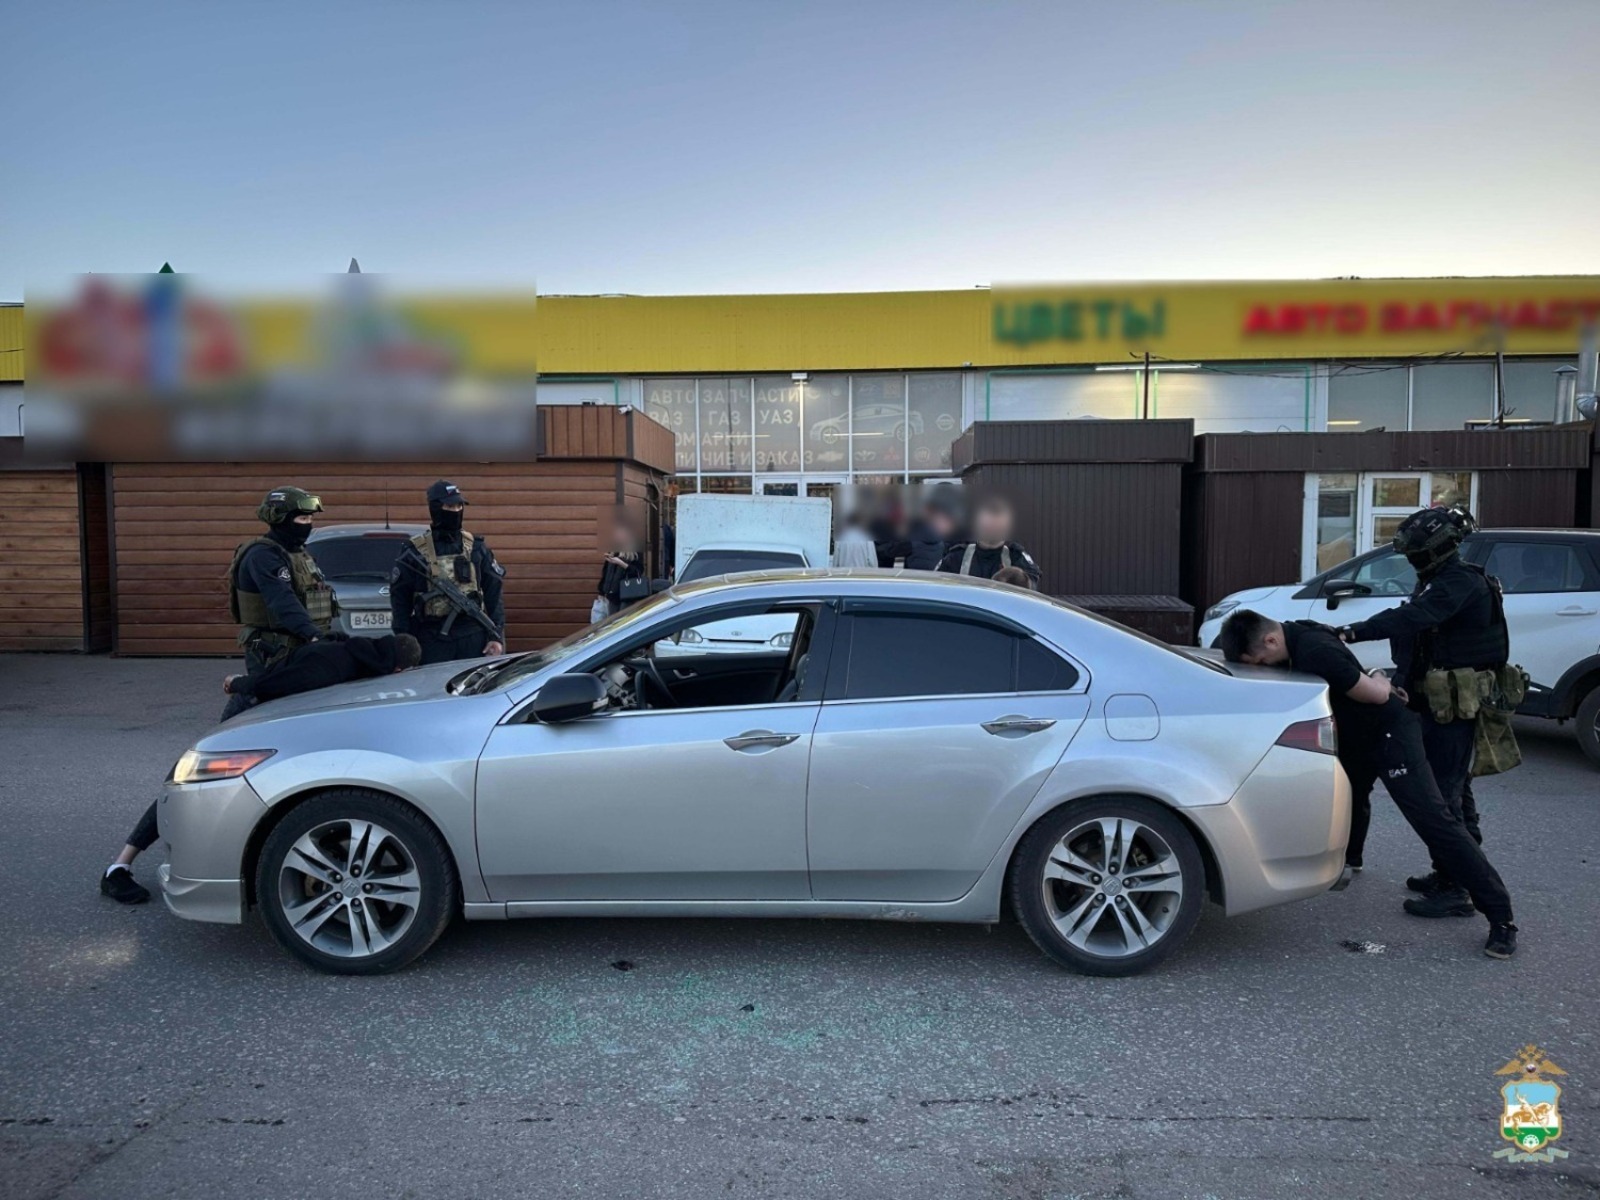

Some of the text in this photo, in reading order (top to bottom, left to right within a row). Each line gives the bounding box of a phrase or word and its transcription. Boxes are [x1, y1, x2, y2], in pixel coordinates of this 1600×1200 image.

[993, 298, 1166, 344] ЦВЕТЫ
[708, 410, 741, 425] ГАЗ
[675, 431, 748, 447] ОМАРКИ
[354, 612, 392, 626] В438Н
